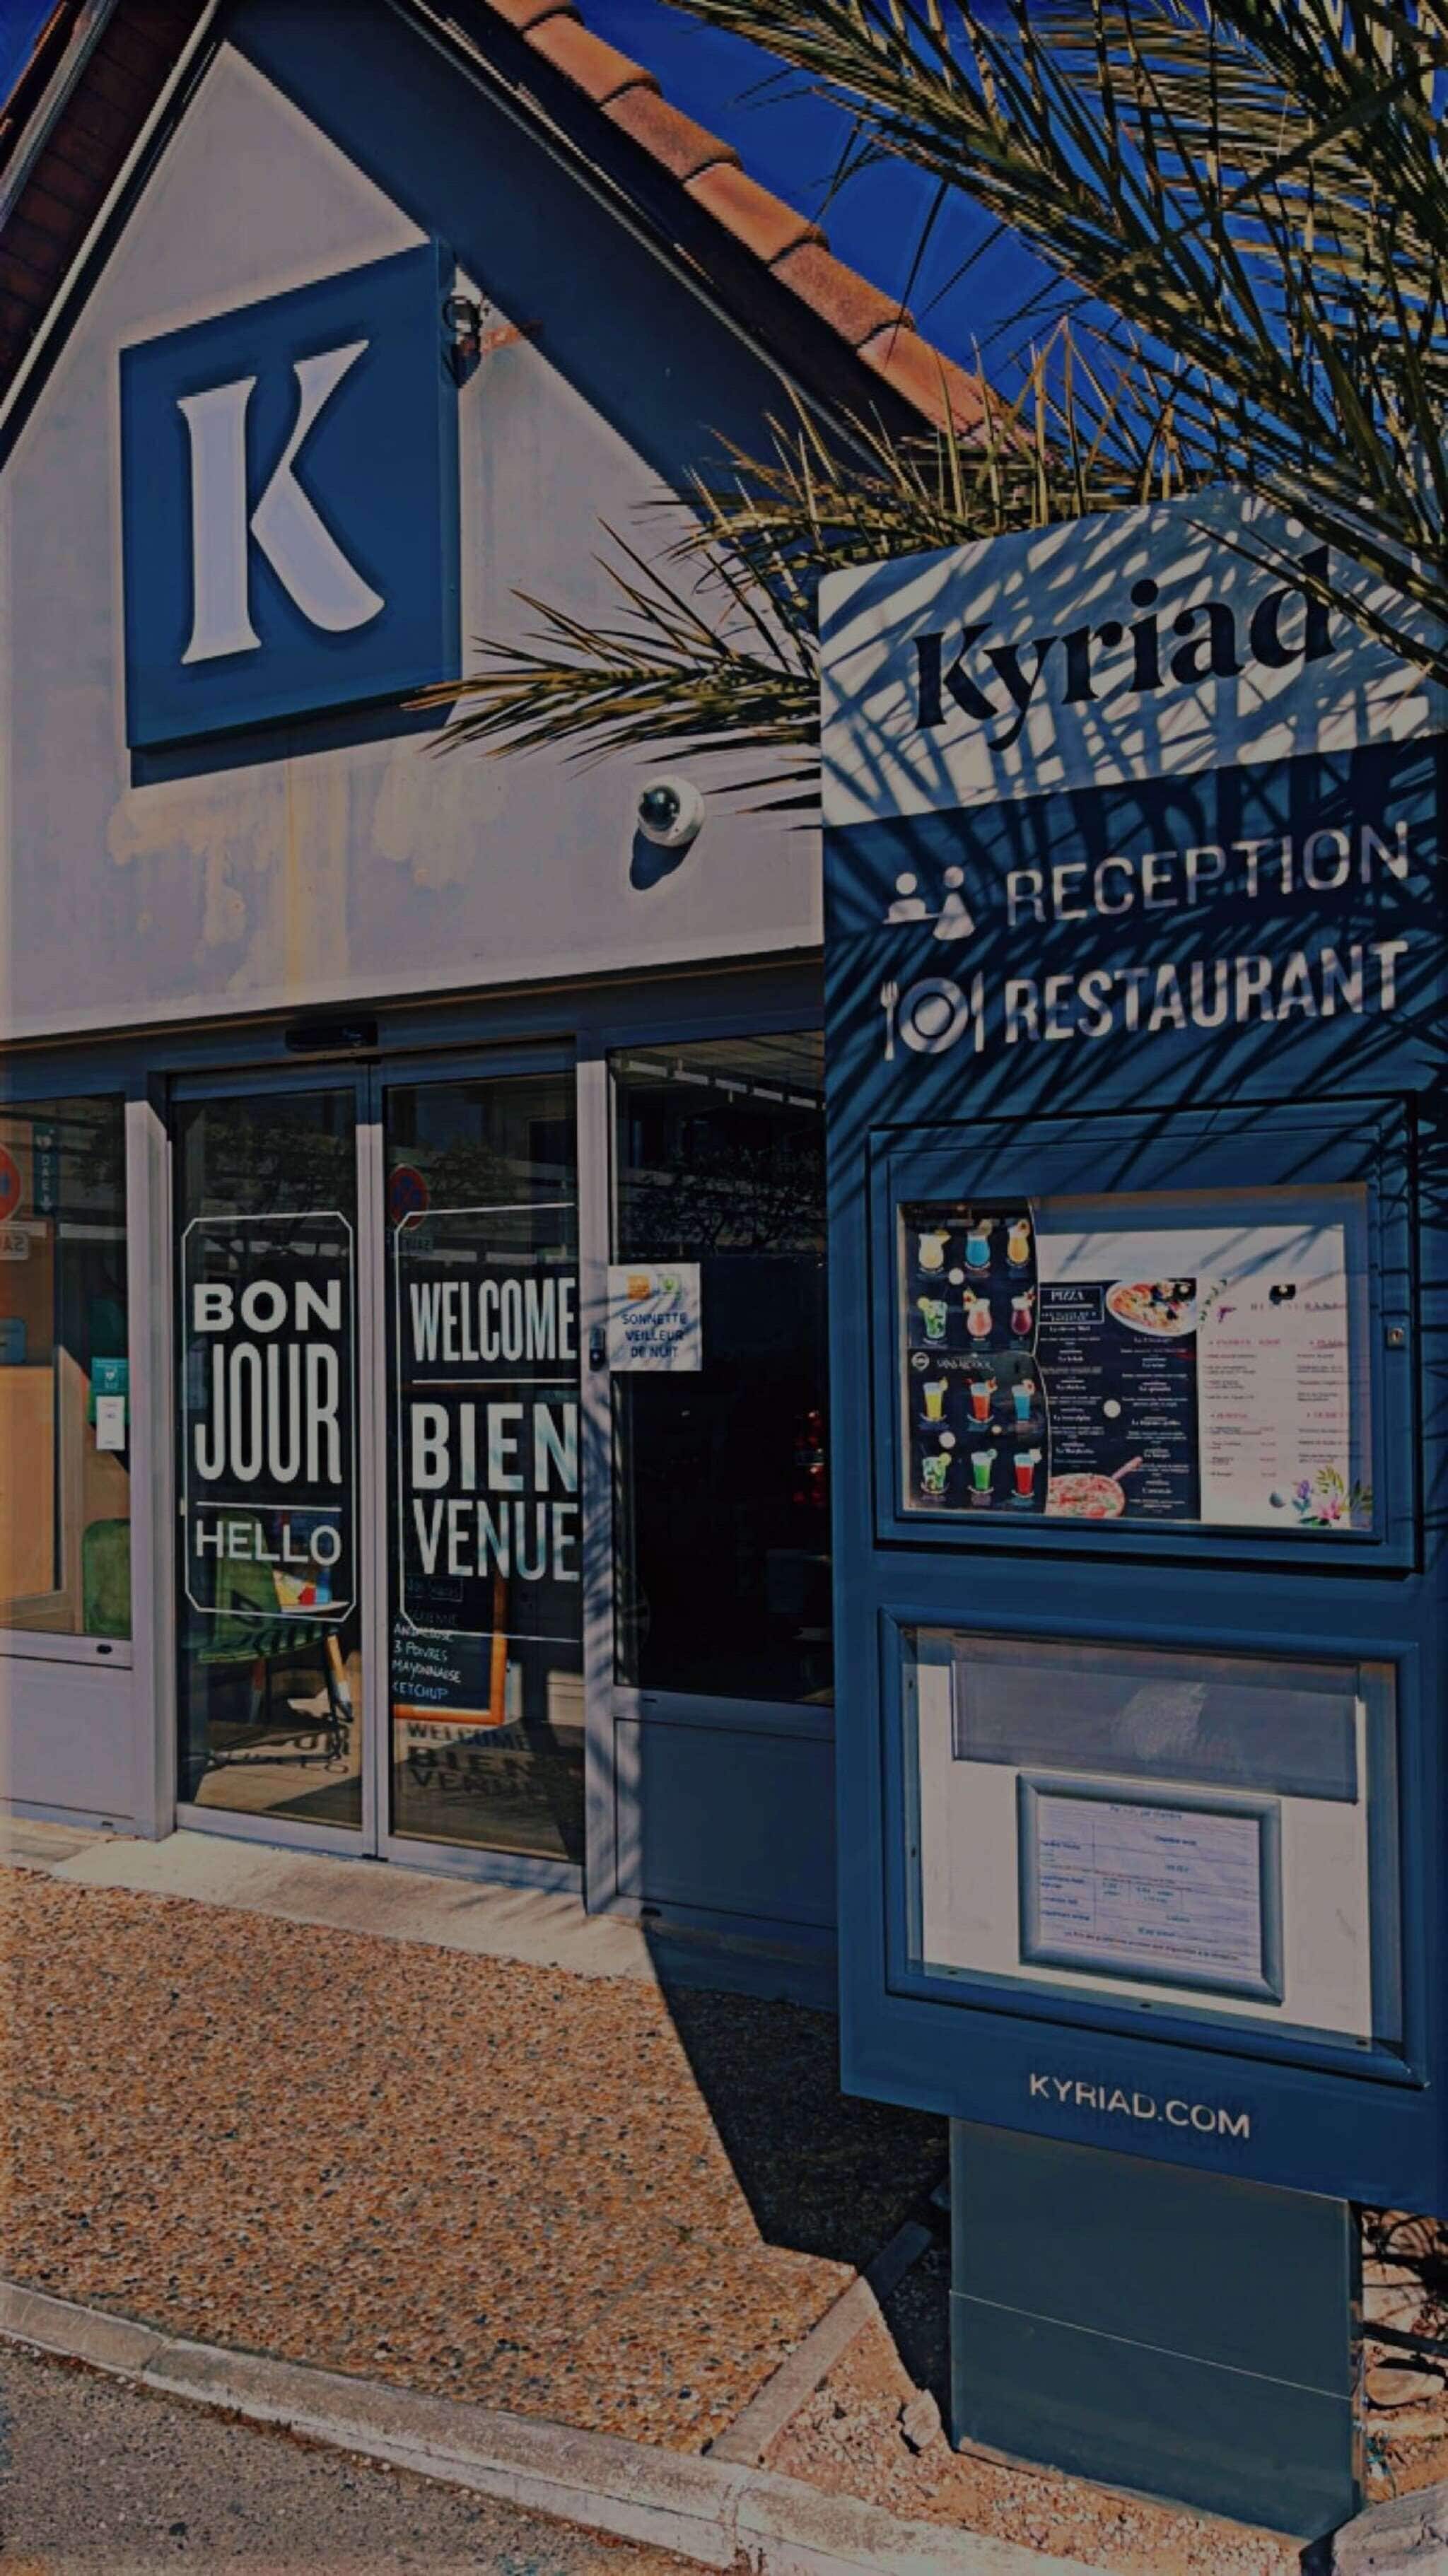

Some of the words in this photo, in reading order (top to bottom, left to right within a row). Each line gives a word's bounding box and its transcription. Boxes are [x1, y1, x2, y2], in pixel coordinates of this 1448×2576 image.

[176, 339, 385, 665] K
[914, 543, 1336, 751] Kyriad
[1006, 820, 1408, 927] RECEPTION
[1004, 941, 1409, 1043] RESTAURANT
[193, 1280, 341, 1333] BON
[409, 1277, 578, 1362] WELCOME
[622, 1312, 688, 1325] SONNETTE
[626, 1330, 684, 1341] VEILLEUR
[647, 1345, 678, 1358] NUIT
[195, 1342, 342, 1484] JOUR
[411, 1403, 580, 1492] BIEN
[196, 1520, 341, 1567] HELLO
[413, 1498, 580, 1581] VENUE
[1029, 2072, 1251, 2139] KYRIAD.COM
